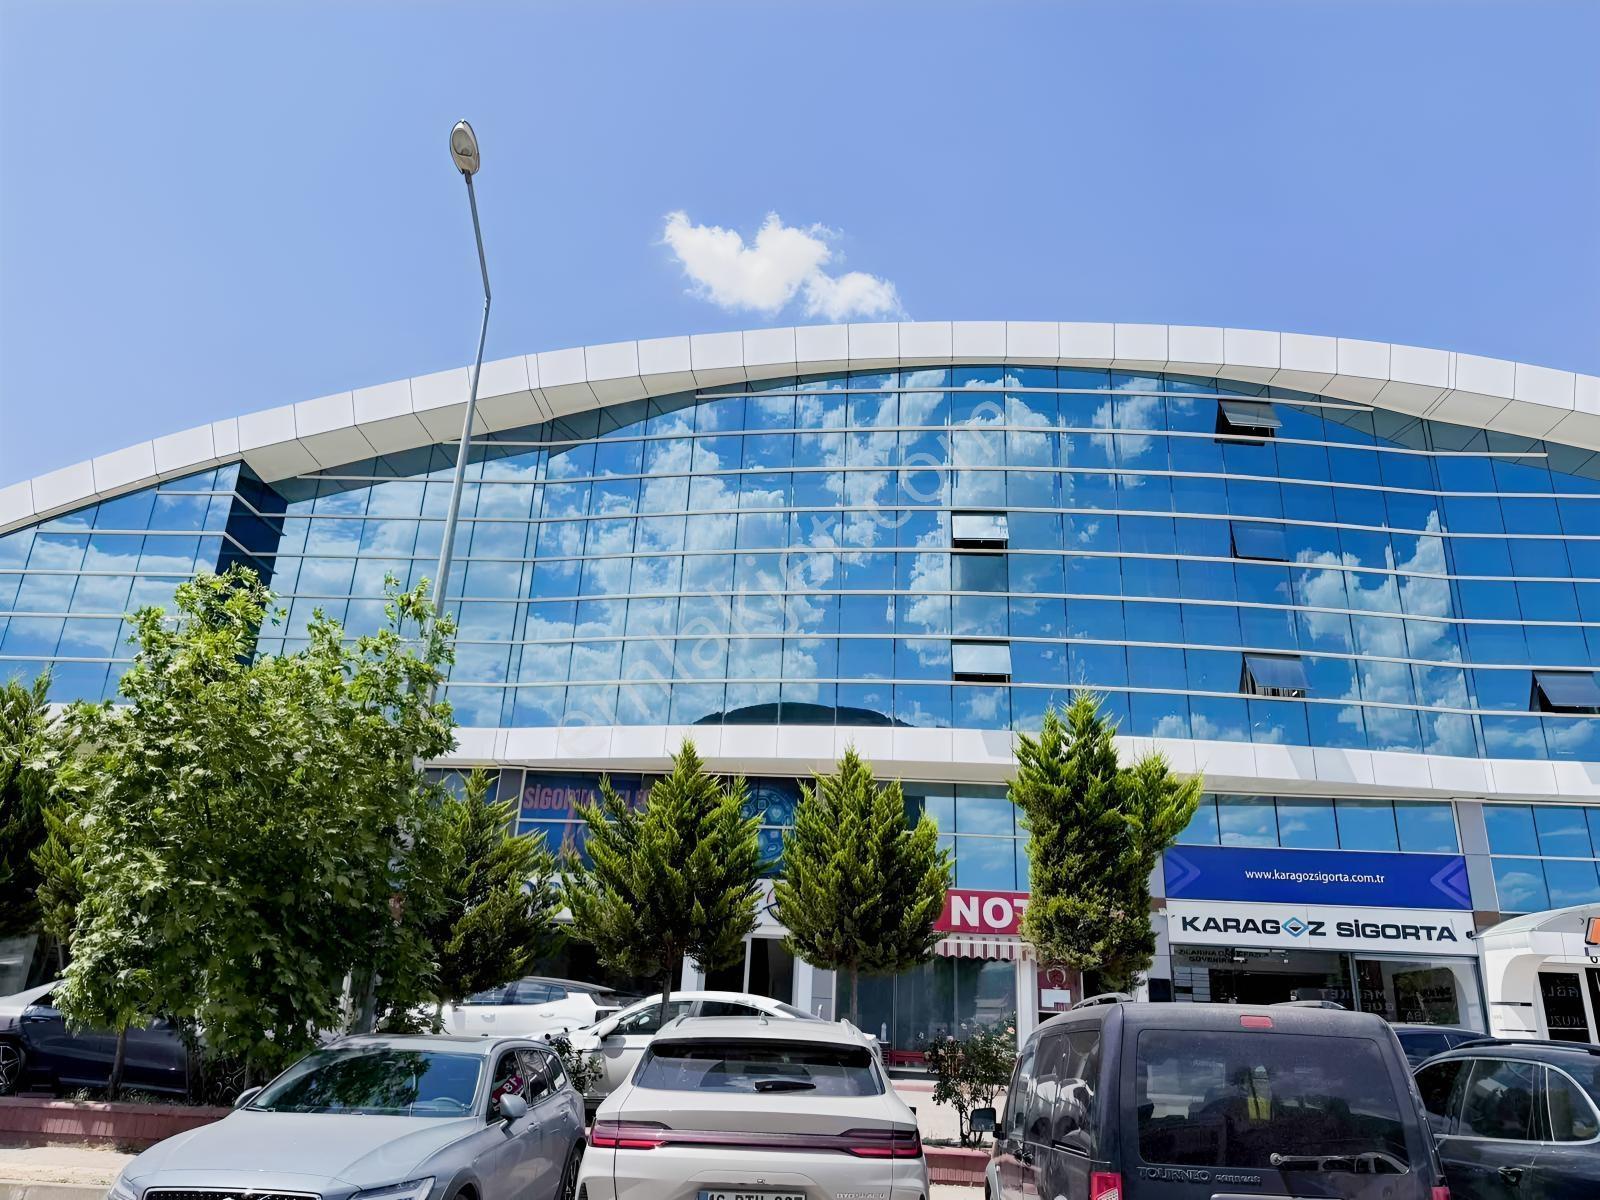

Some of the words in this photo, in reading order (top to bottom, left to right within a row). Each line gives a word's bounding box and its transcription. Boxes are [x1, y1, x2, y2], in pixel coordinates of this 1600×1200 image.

[1245, 868, 1385, 884] www.karagozsigorta.com.tr
[1336, 918, 1457, 942] SİGORTA
[1137, 1166, 1210, 1182] TOURNEO
